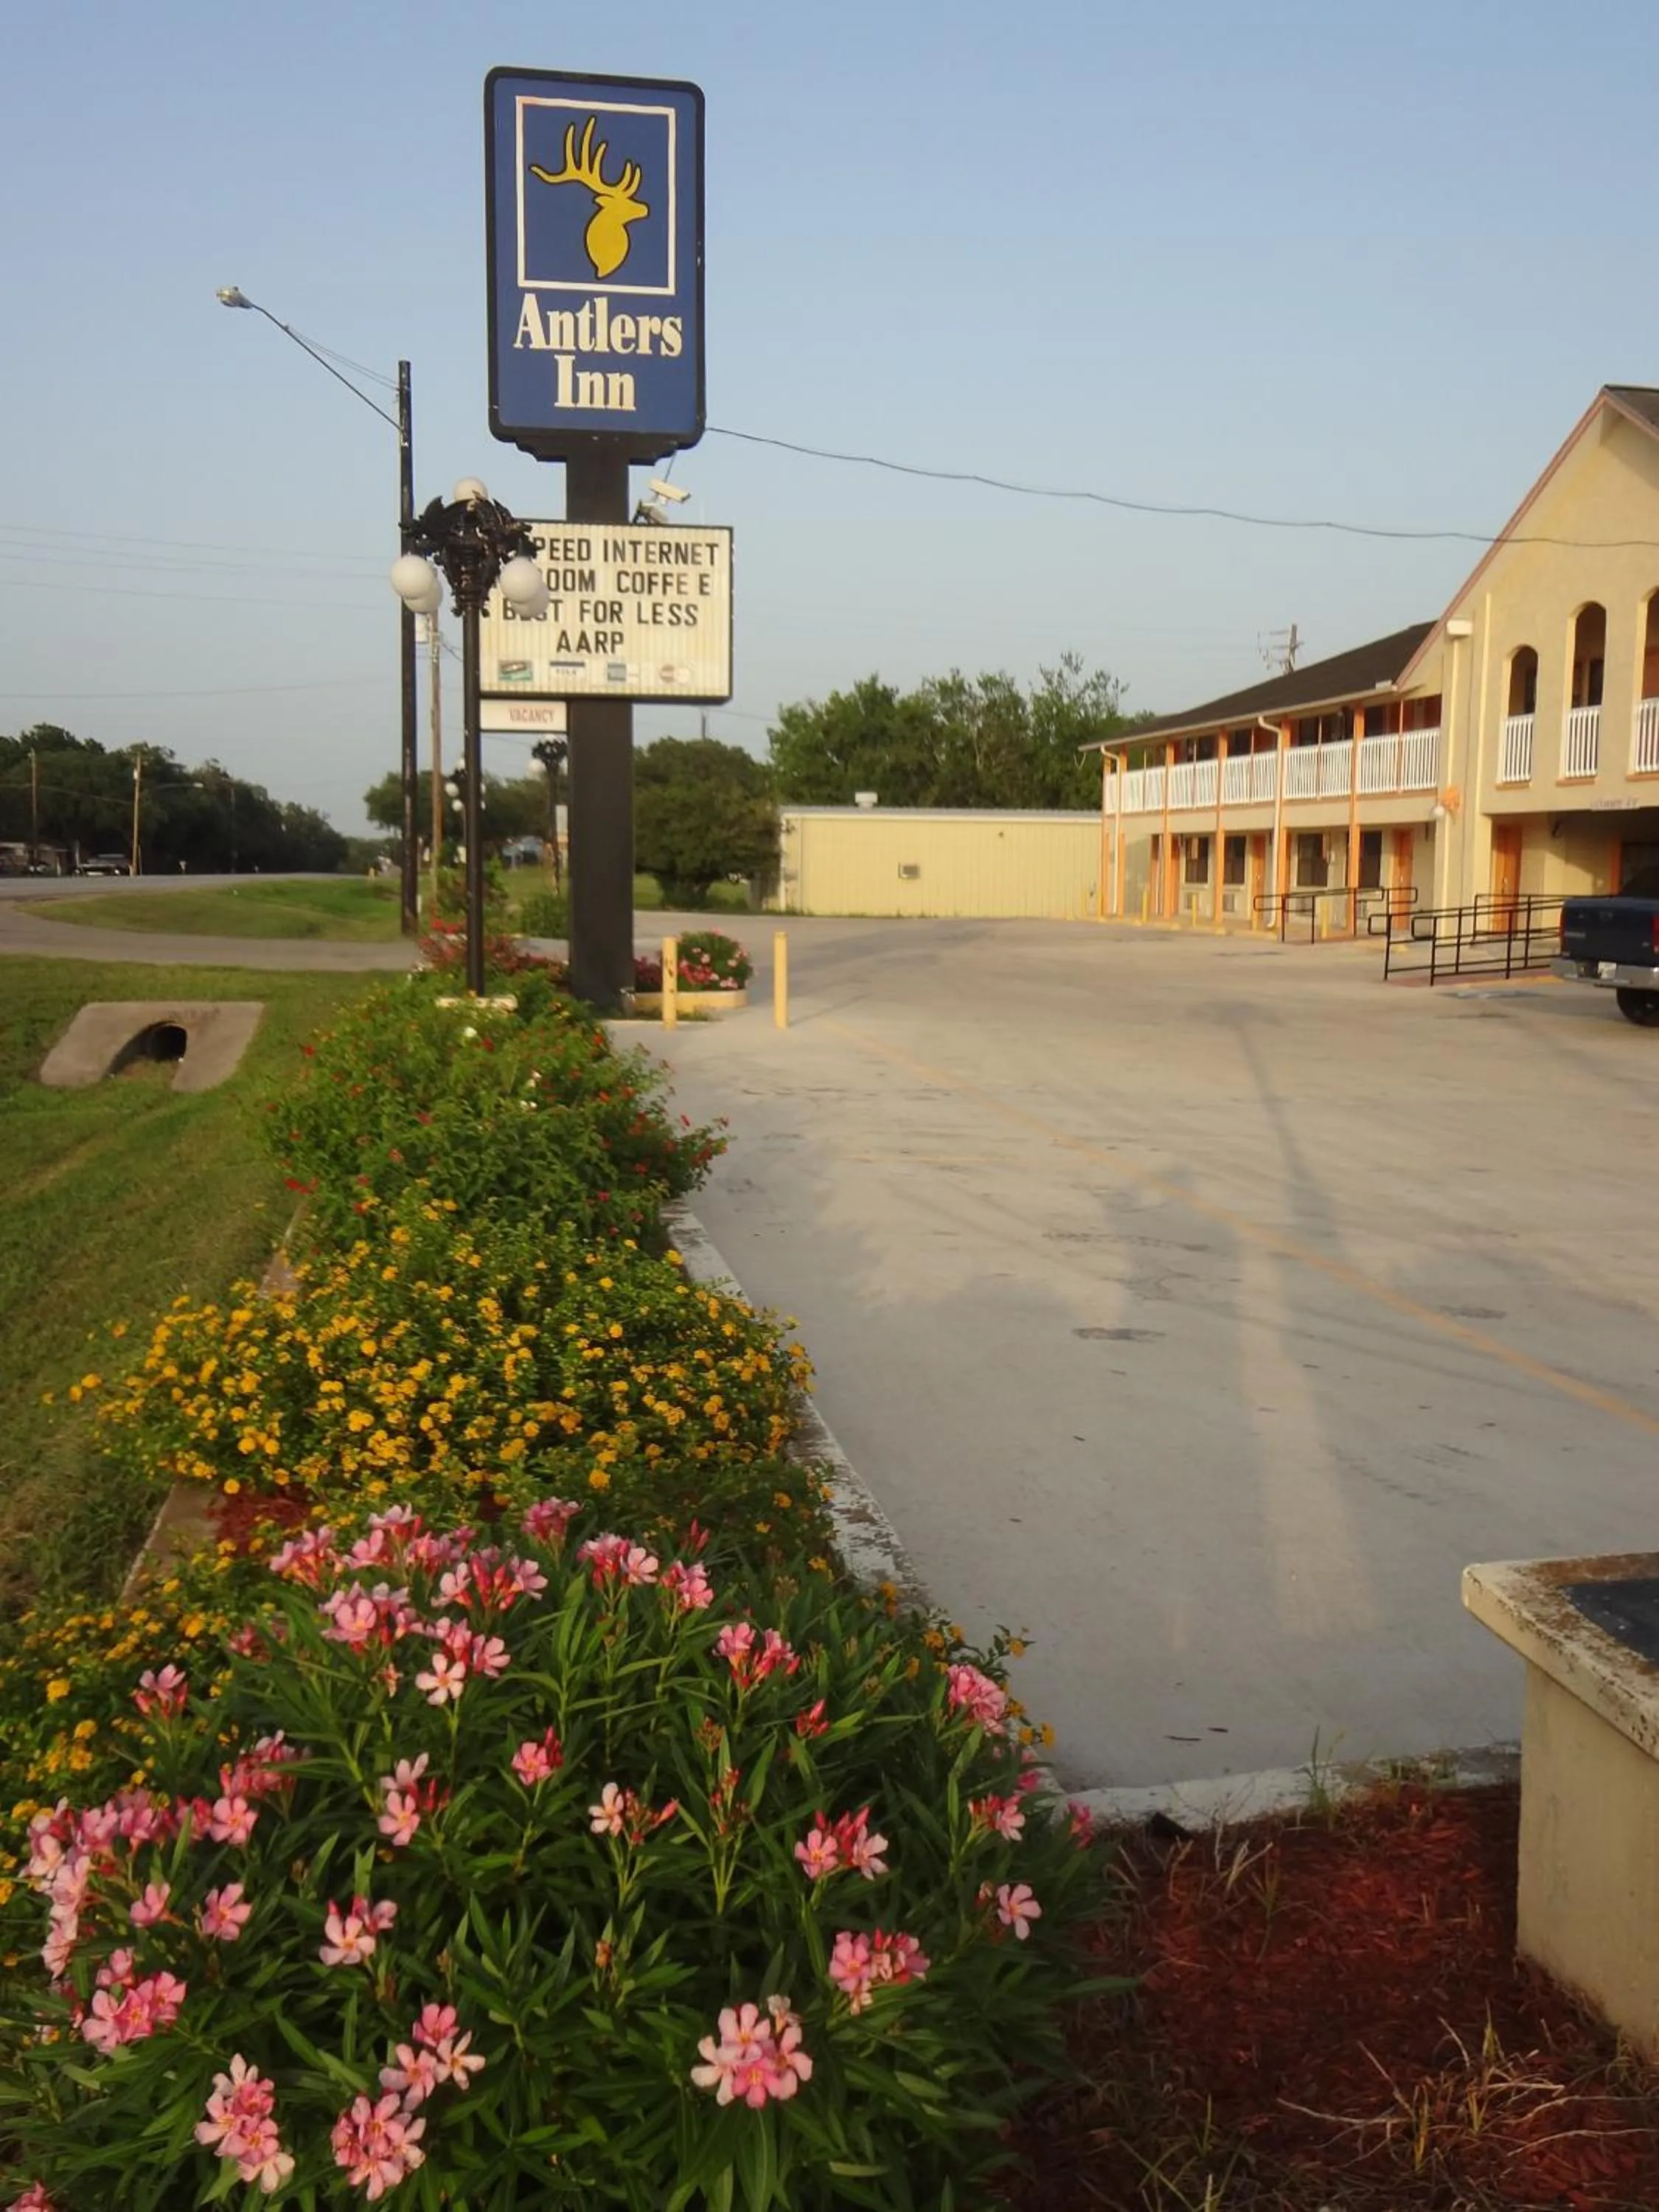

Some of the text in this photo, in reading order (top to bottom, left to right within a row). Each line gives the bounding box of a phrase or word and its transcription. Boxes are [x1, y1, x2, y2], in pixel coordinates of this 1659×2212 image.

[513, 293, 683, 357] Antlers
[554, 354, 636, 411] Inn
[532, 536, 720, 566] PEED INTERNET
[538, 568, 596, 592] OOM
[579, 599, 624, 625] FOR
[636, 602, 699, 627] LESS
[556, 630, 625, 654] AARP
[509, 709, 554, 723] VACANCY
